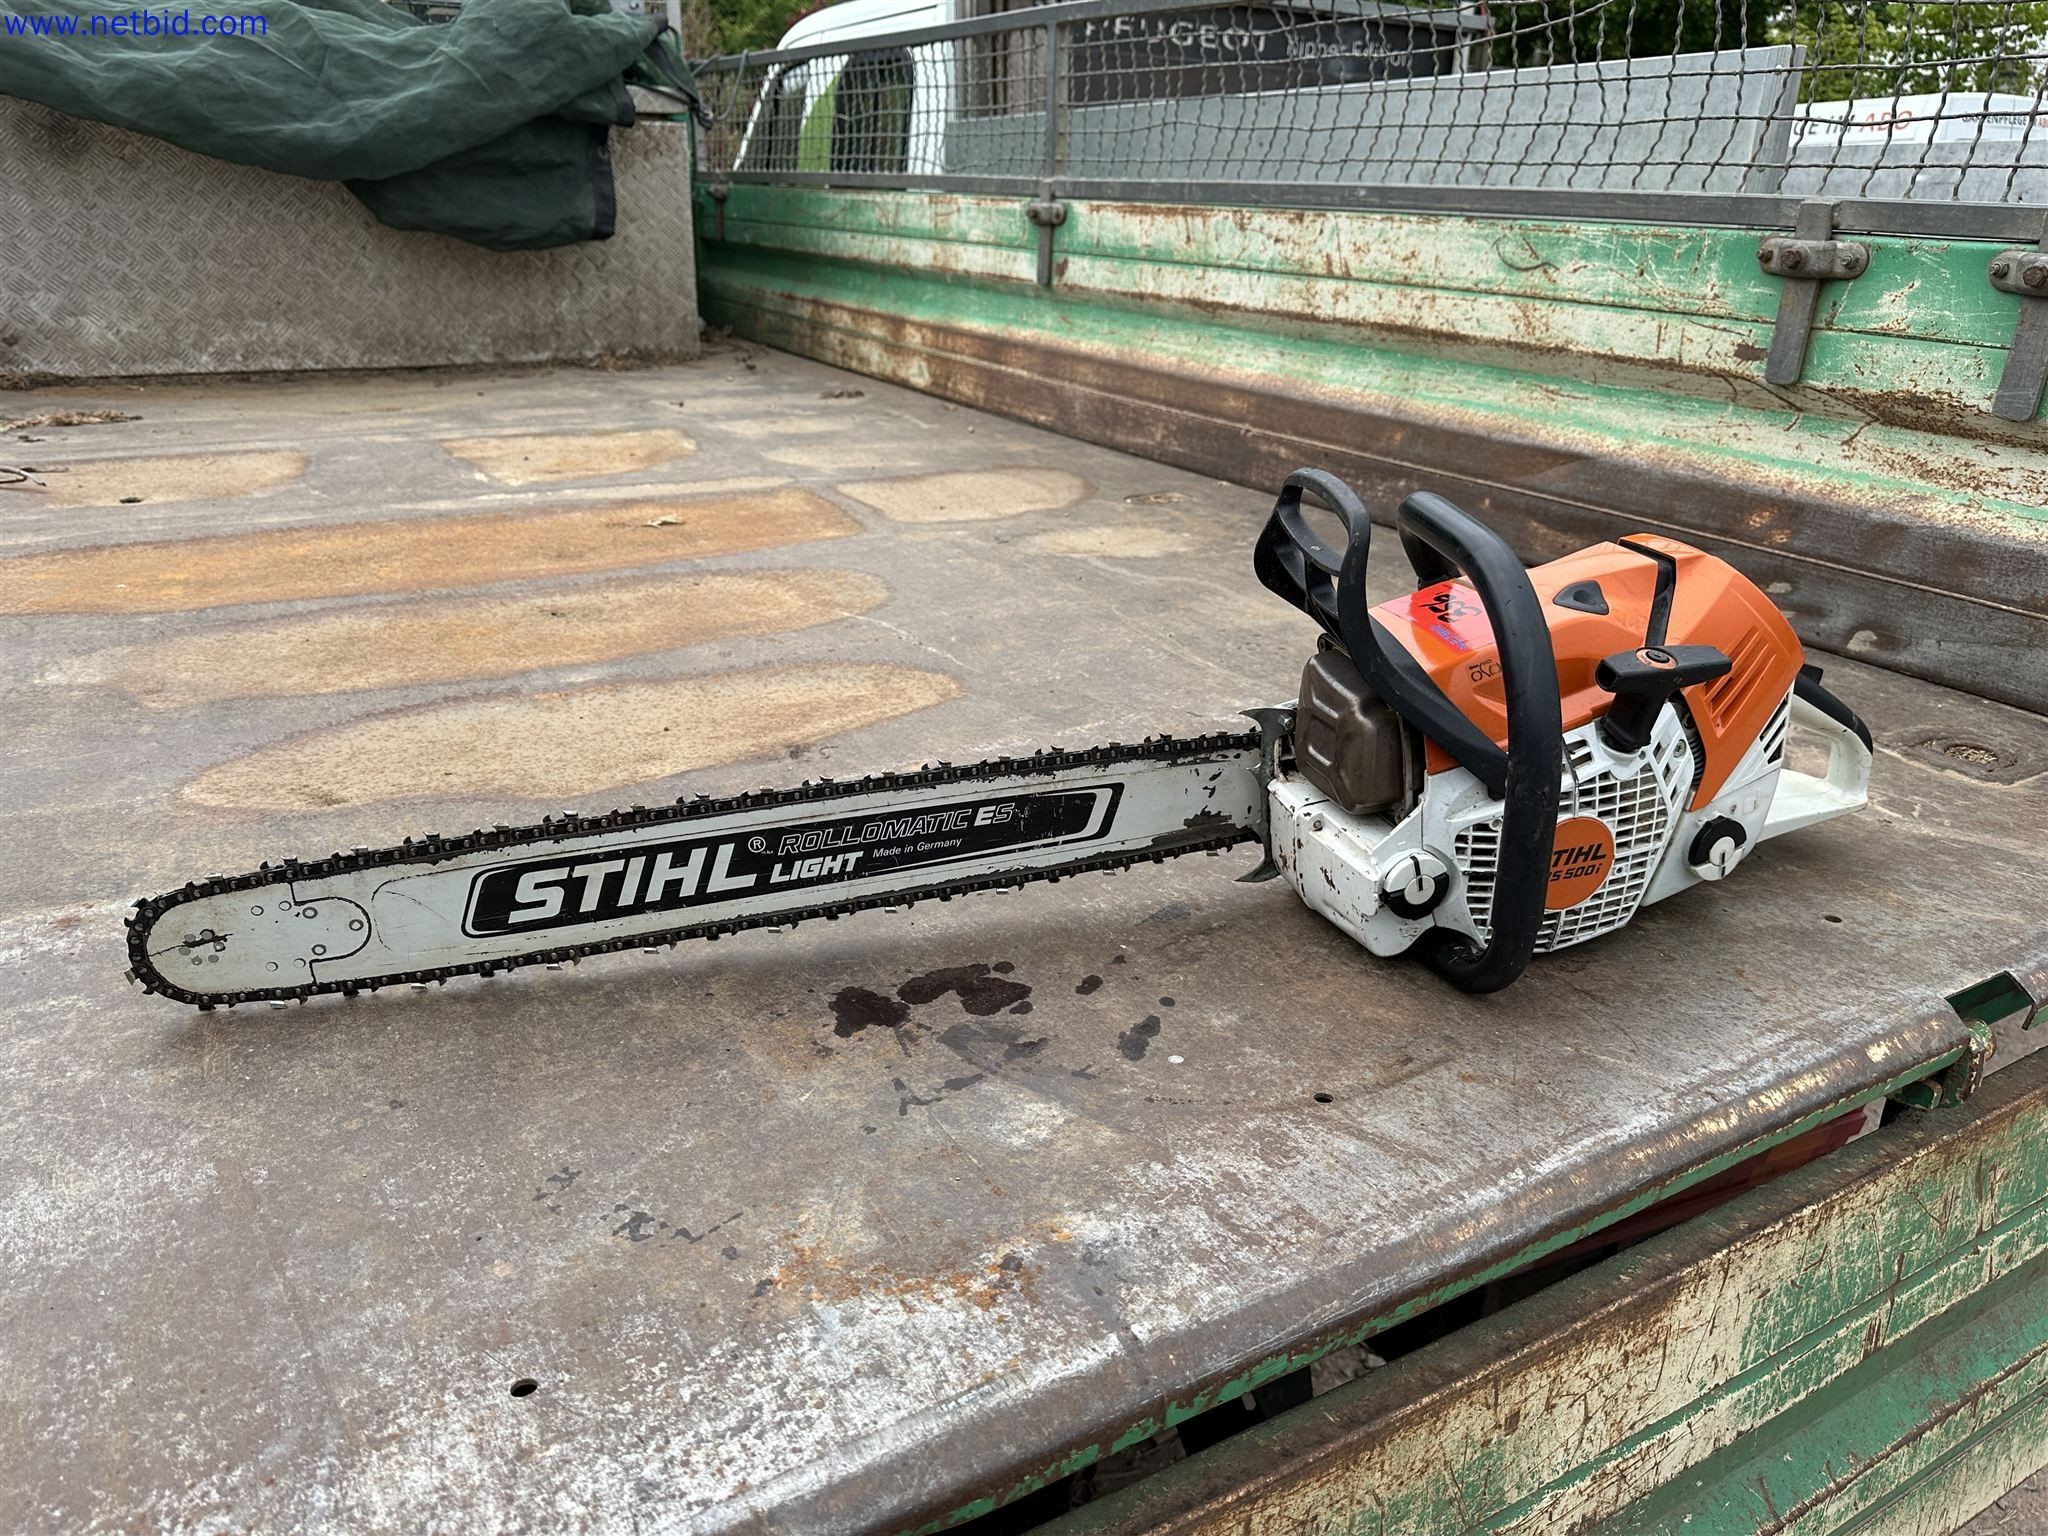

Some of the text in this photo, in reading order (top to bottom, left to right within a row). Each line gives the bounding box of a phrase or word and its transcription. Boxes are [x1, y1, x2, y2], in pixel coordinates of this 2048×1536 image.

[778, 802, 1016, 856] ROLLOMATIC ES
[873, 838, 962, 858] Made in Germany
[1551, 843, 1606, 868] TIHL
[769, 851, 864, 884] LIGHT
[1548, 863, 1602, 882] S 500i
[508, 843, 757, 924] STIHL
